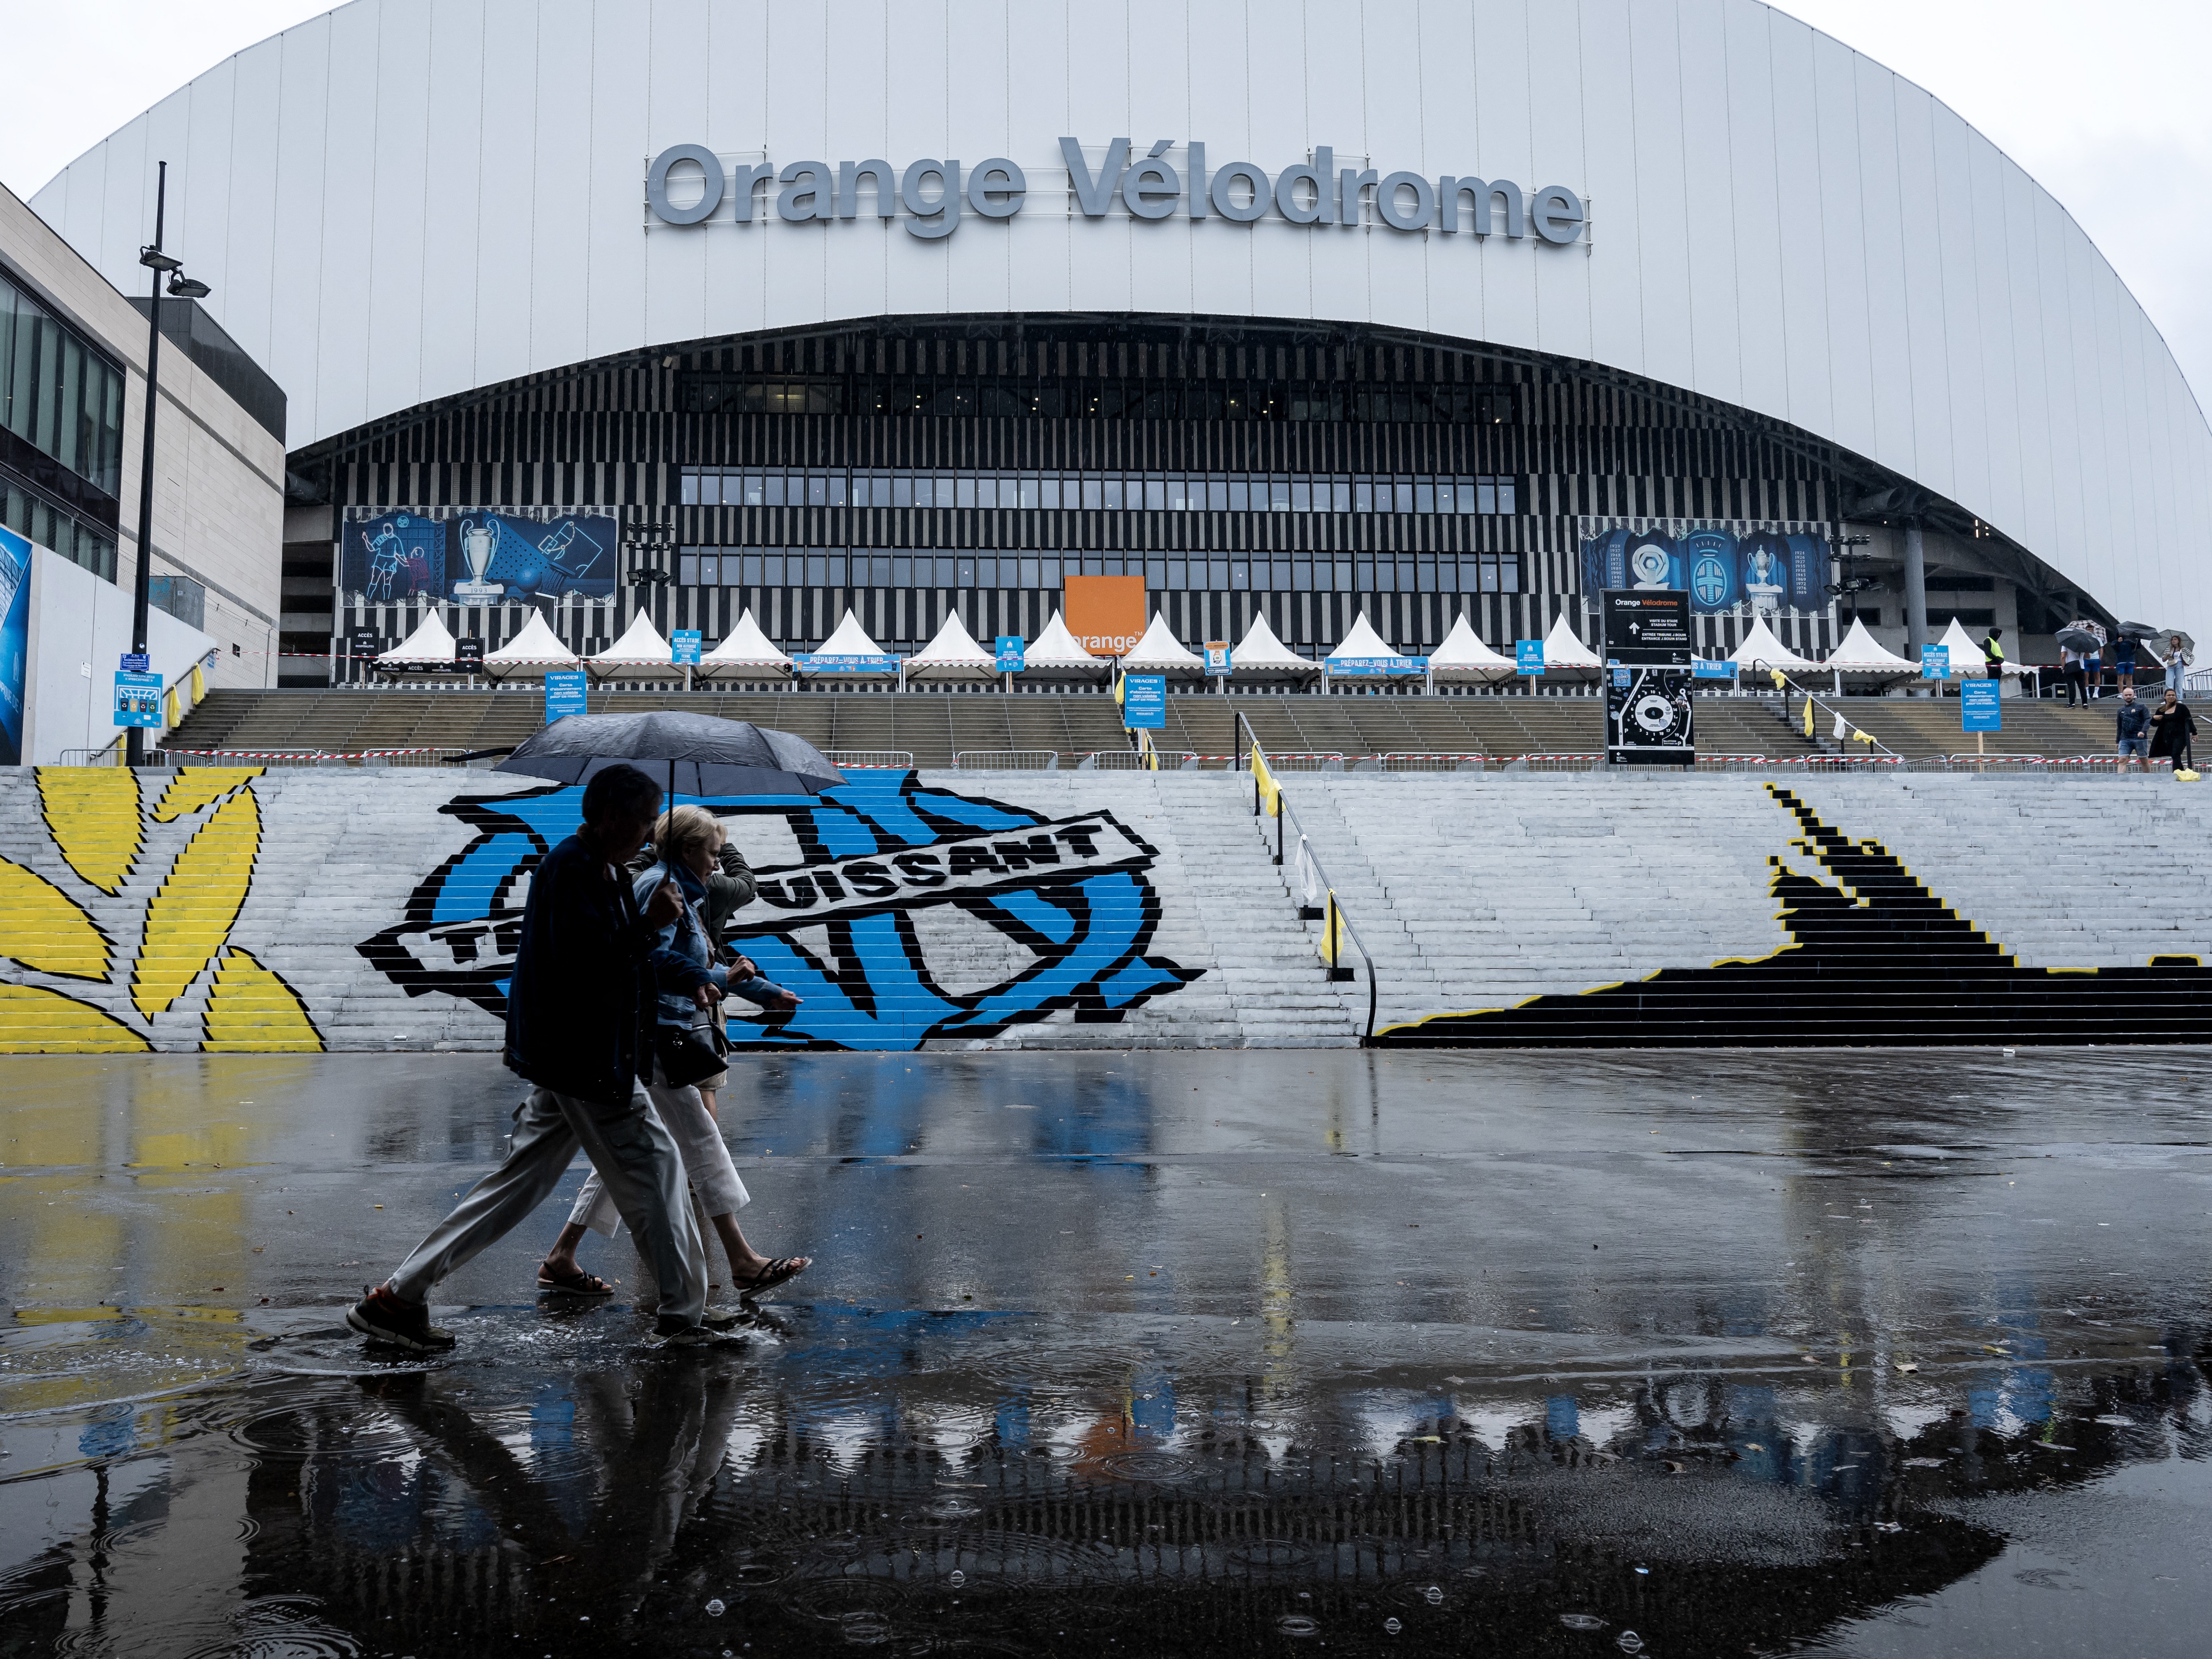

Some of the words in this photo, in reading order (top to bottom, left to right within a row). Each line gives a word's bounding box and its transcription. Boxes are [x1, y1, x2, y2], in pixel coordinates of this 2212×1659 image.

[647, 144, 1026, 239] Orange
[1058, 137, 1583, 244] Vélodrome
[860, 655, 864, 664] À
[1390, 658, 1394, 666] À
[1700, 661, 1704, 670] À
[756, 825, 1102, 909] UISSANT
